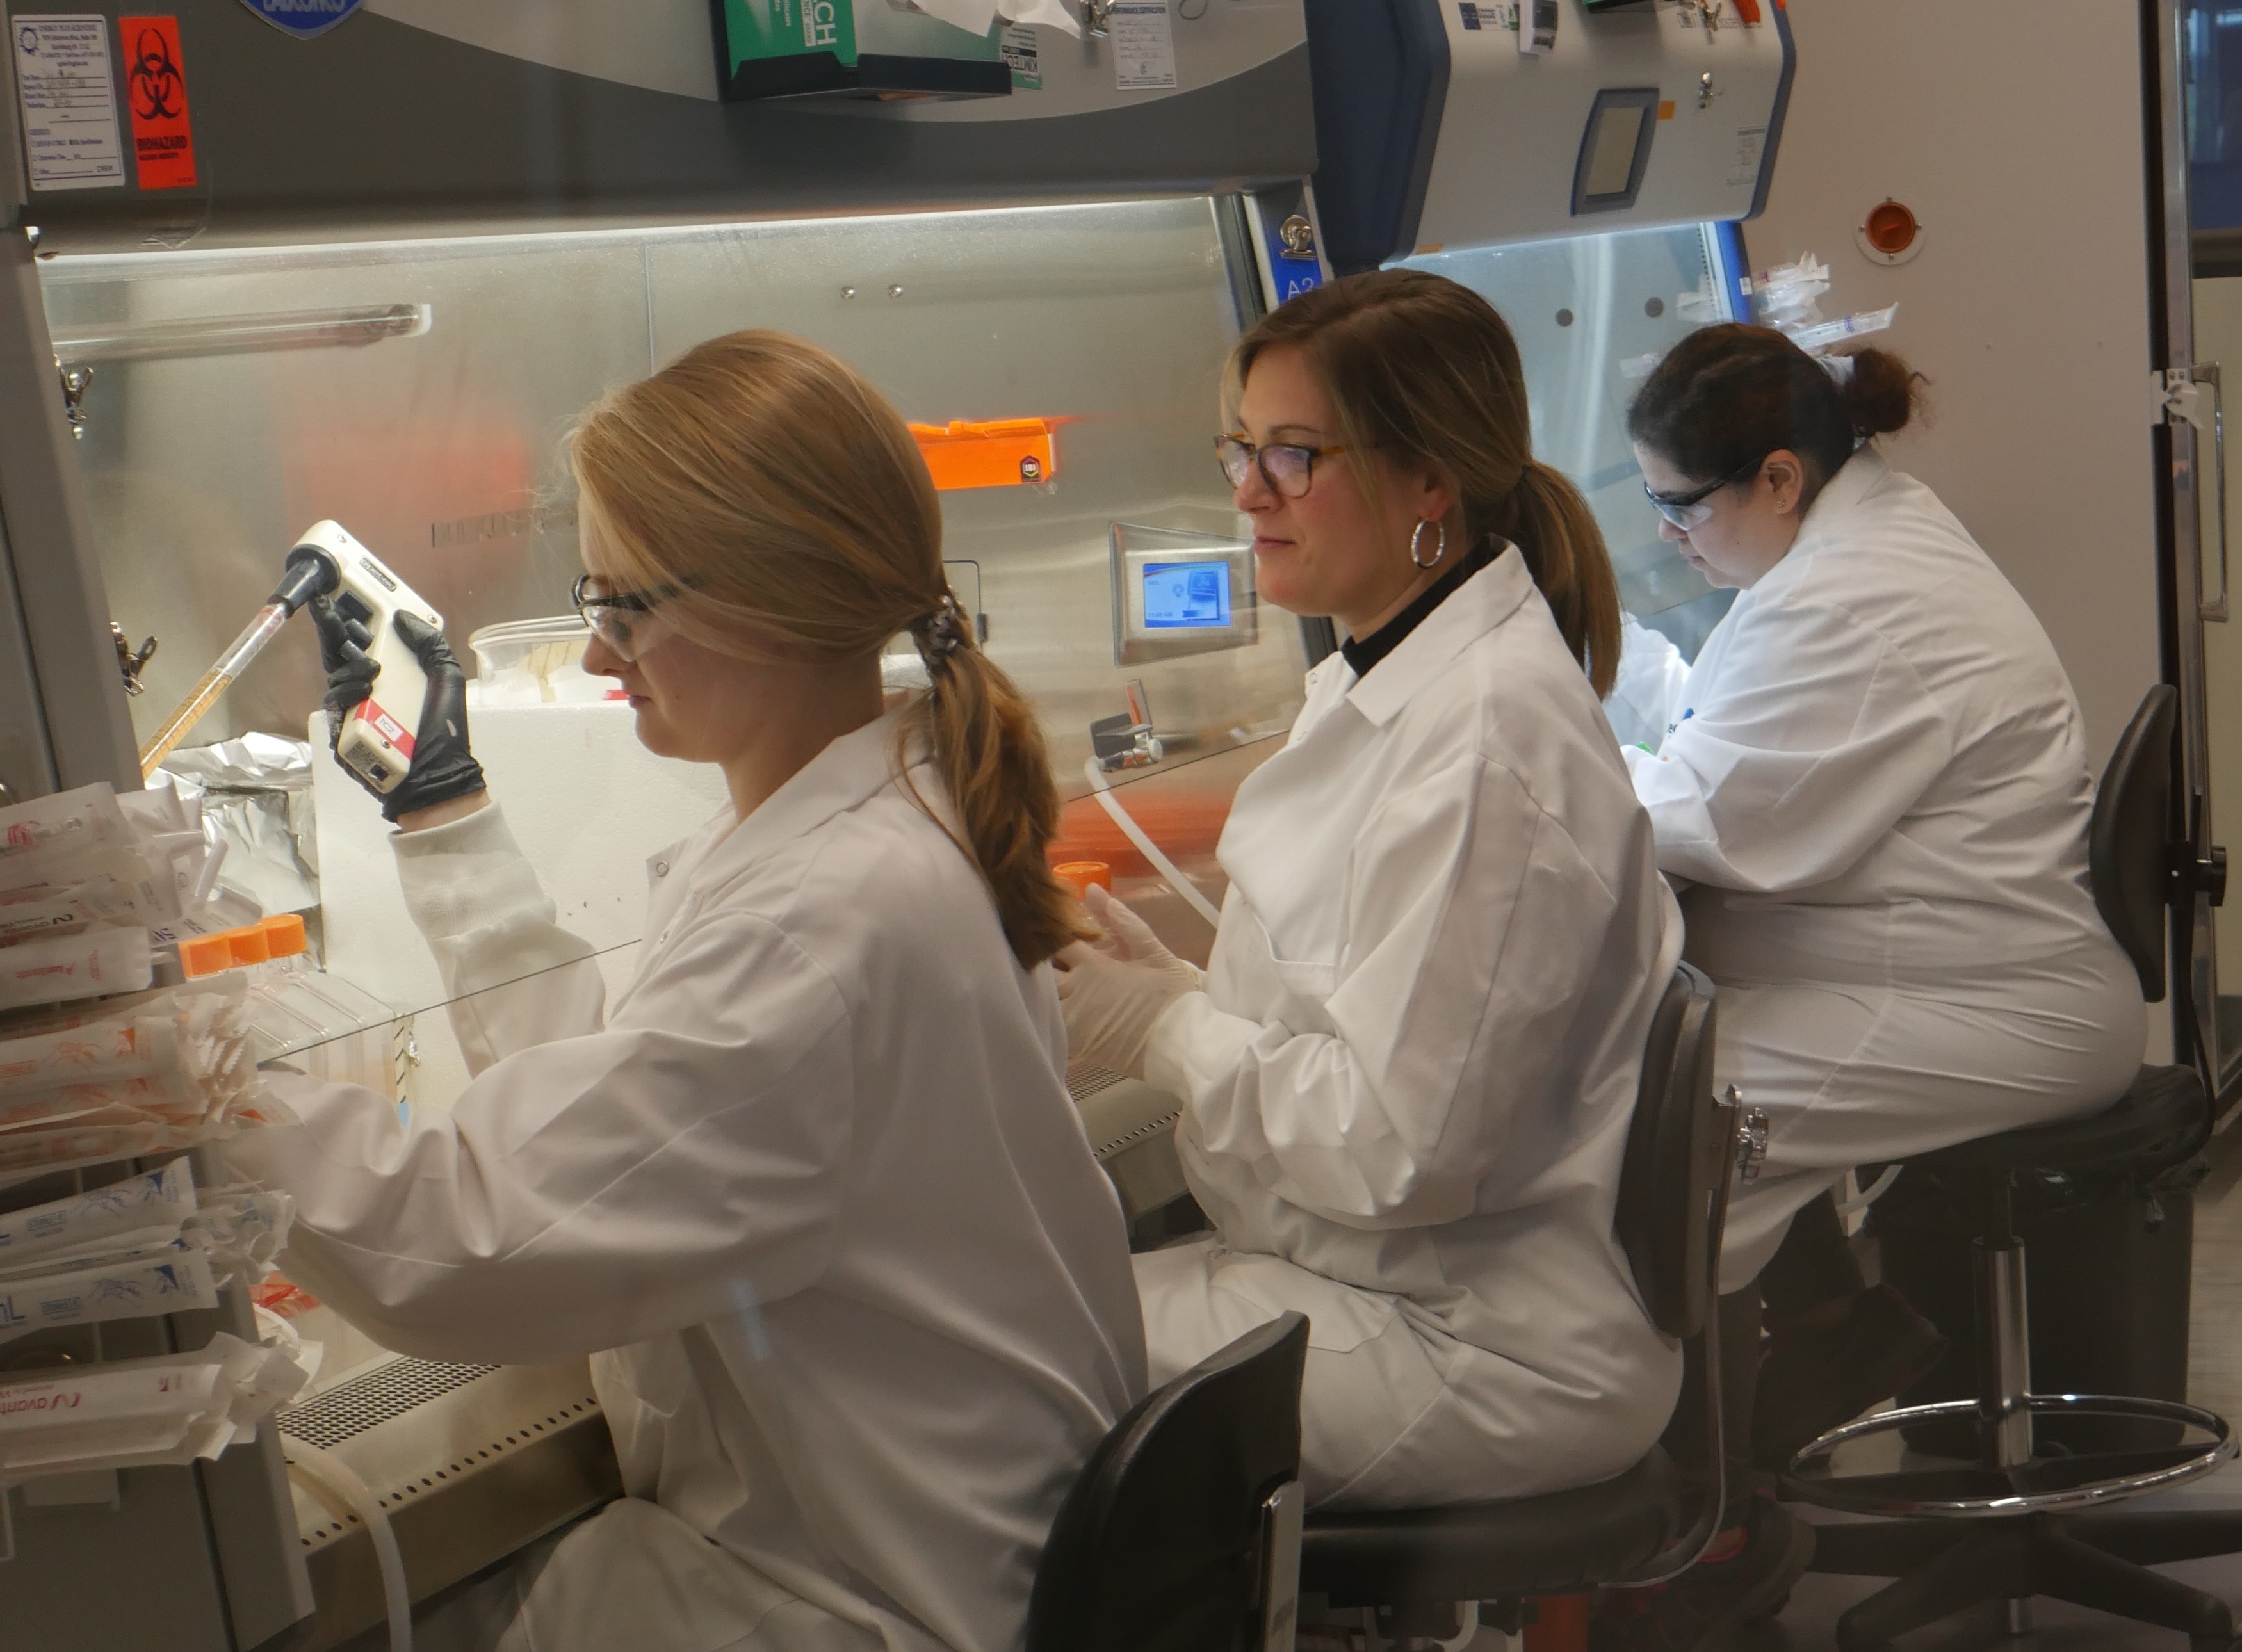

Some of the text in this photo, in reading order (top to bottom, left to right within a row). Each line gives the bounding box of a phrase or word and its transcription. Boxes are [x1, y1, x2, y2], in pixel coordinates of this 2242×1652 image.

[814, 0, 837, 44] CH
[136, 135, 187, 150] BIOHAZARD
[1288, 277, 1313, 300] A2
[1025, 464, 1036, 472] IBI
[378, 717, 395, 734] TC2
[0, 1397, 50, 1414] avant
